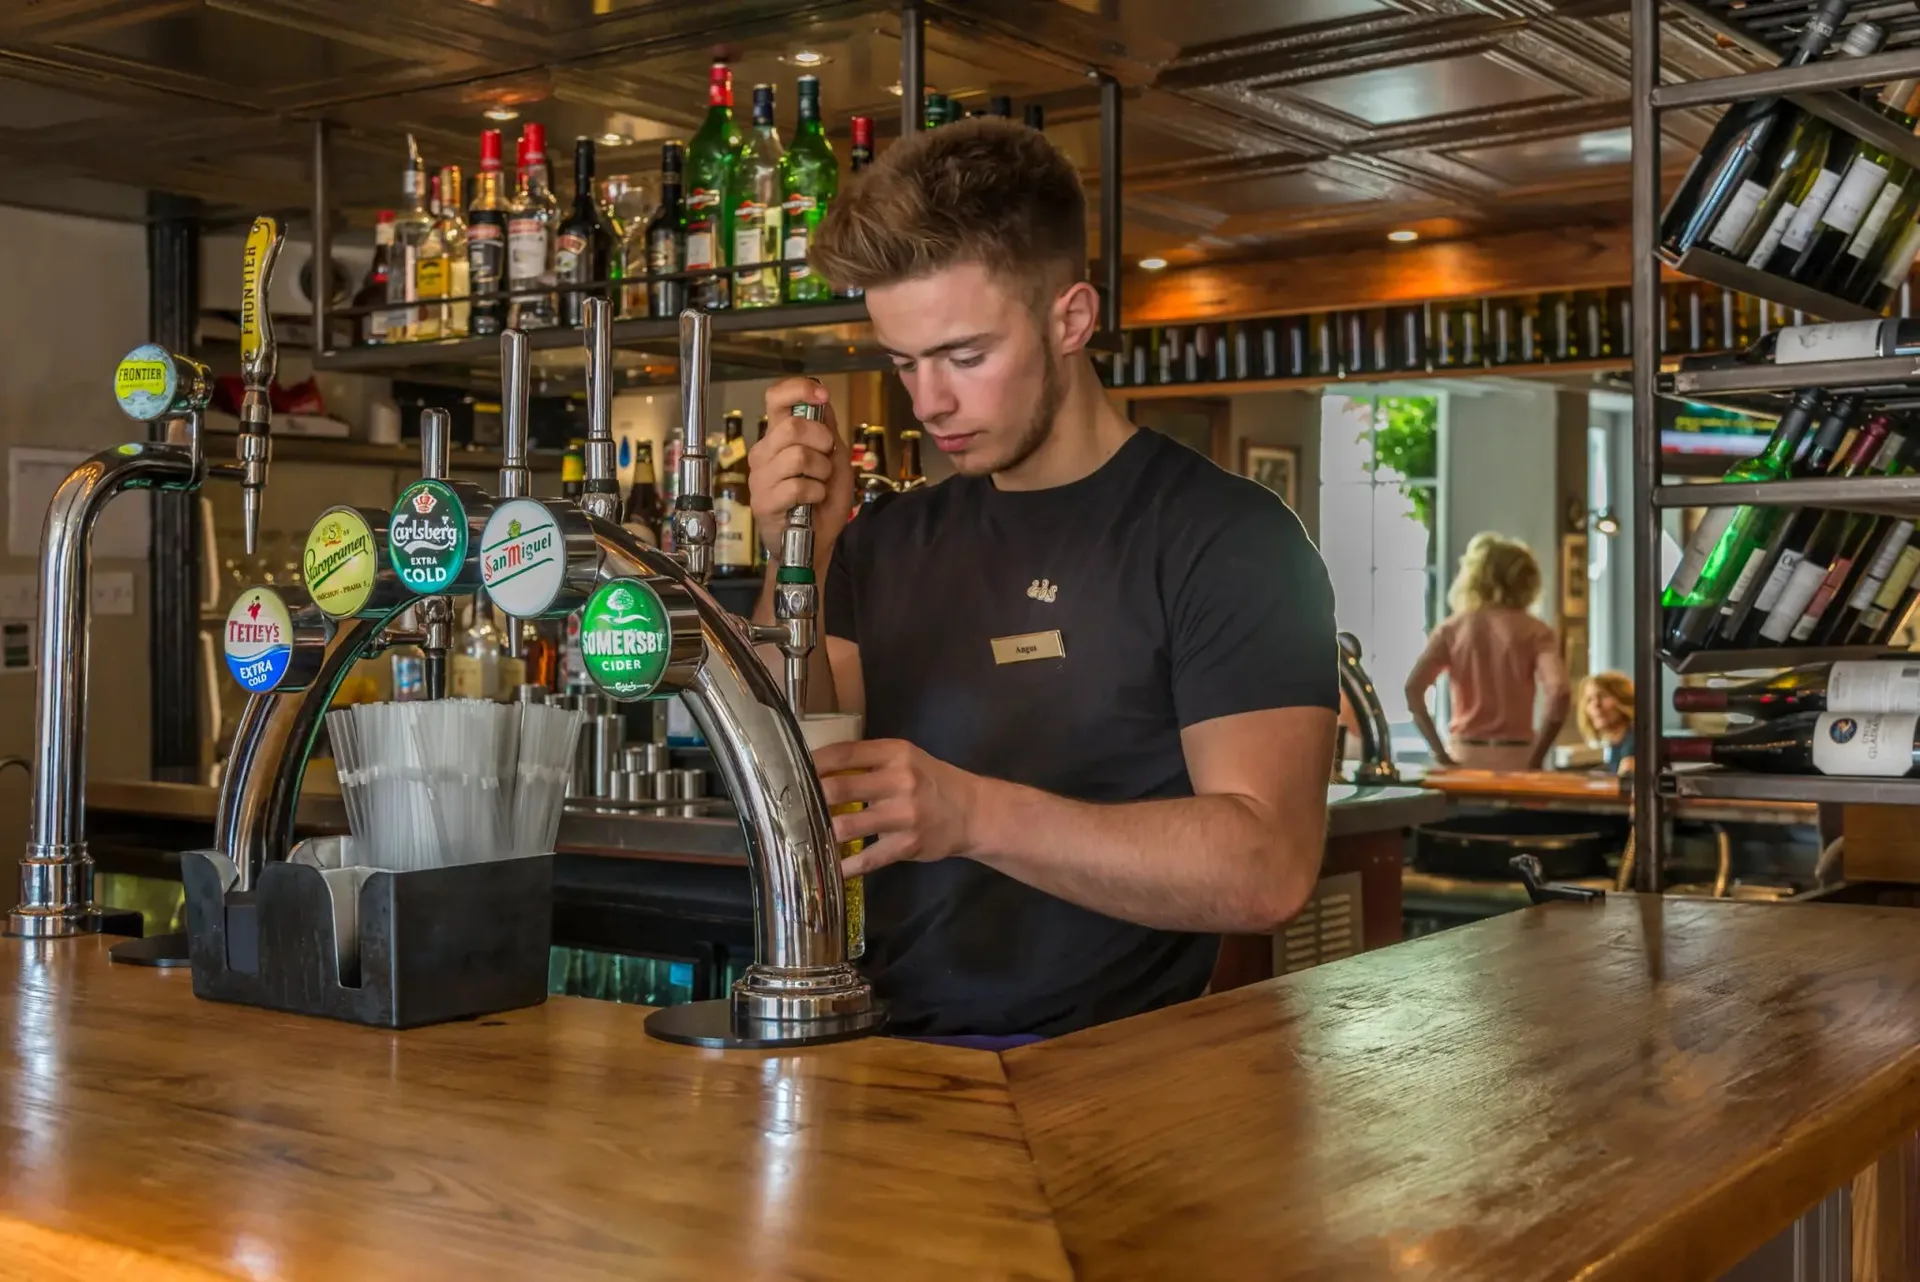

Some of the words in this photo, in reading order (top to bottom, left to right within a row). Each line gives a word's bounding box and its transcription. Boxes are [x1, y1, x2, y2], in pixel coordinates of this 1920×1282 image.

[243, 246, 256, 335] FRONTIER
[118, 366, 162, 382] FRONTIER
[391, 514, 457, 551] Carlsberg
[304, 533, 369, 585] Staropramen
[410, 557, 437, 566] EXTRA
[403, 567, 447, 583] COLD
[583, 630, 664, 656] SOMERSBY
[1015, 645, 1038, 654] Angus
[239, 659, 273, 679] EXTRA
[602, 659, 642, 671] CIDER
[248, 673, 267, 687] COLD
